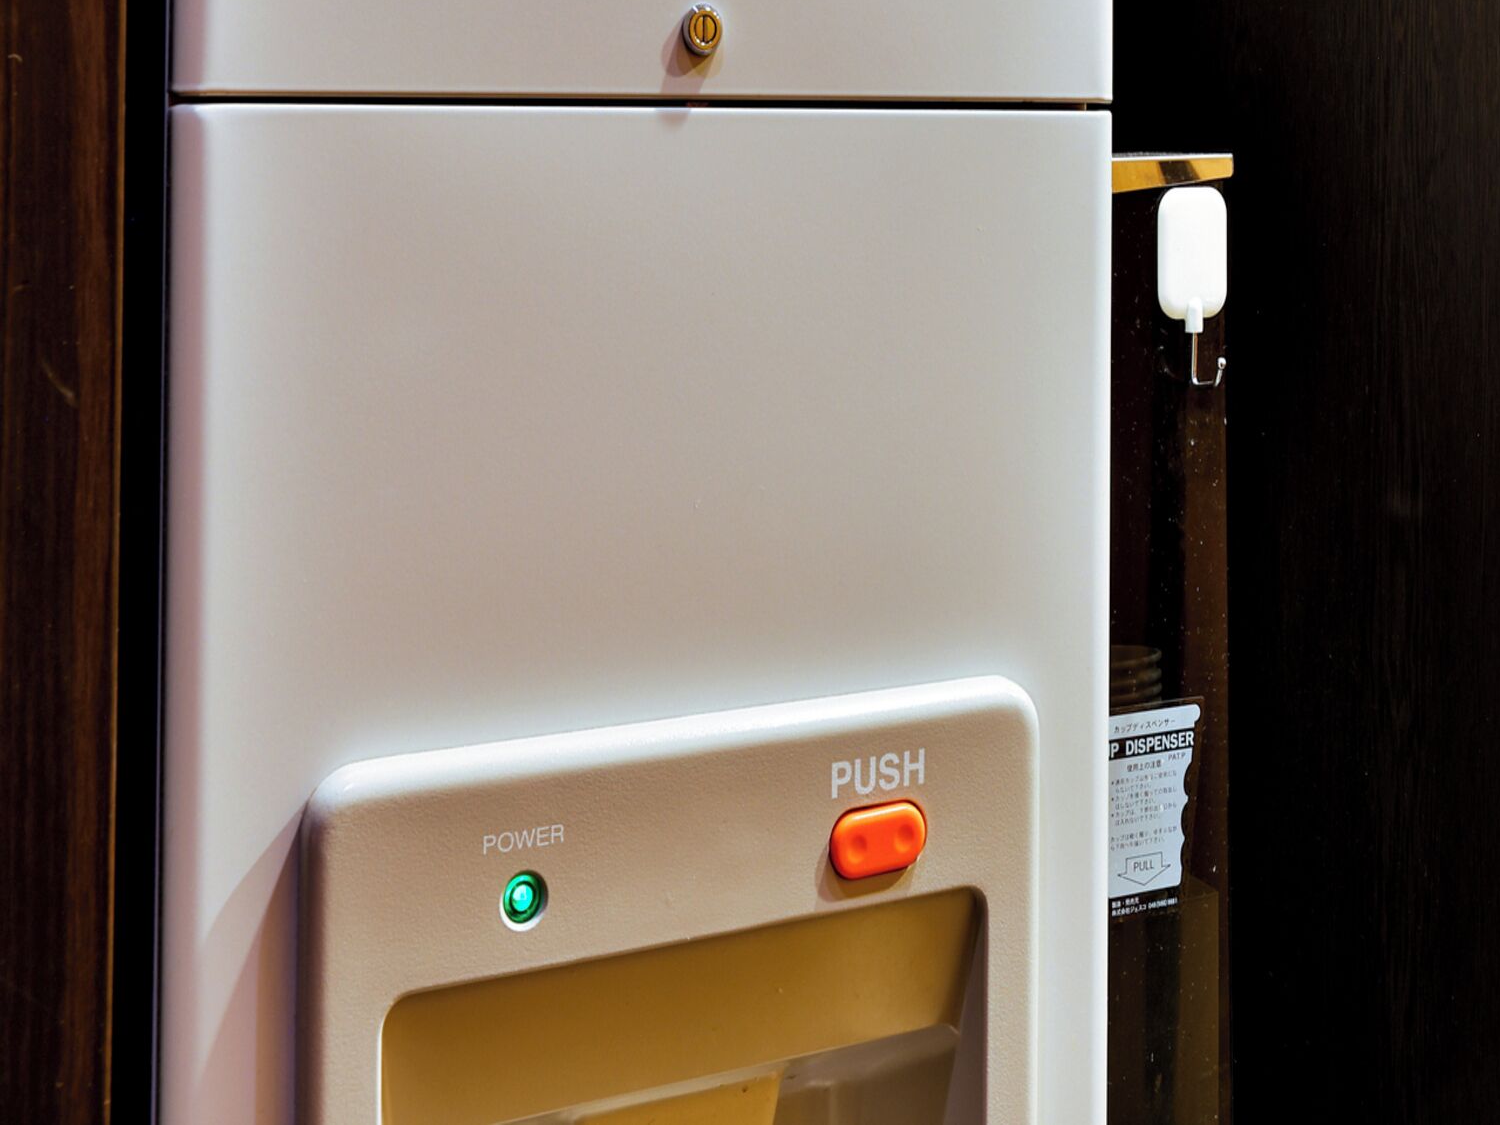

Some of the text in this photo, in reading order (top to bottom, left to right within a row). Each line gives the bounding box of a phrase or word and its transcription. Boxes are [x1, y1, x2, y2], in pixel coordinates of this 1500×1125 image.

[1114, 719, 1176, 734] カップディスペンサー
[1125, 730, 1195, 756] DISPENSER
[830, 748, 926, 799] PUSH
[481, 823, 565, 856] POWER
[1133, 860, 1154, 873] PULL
